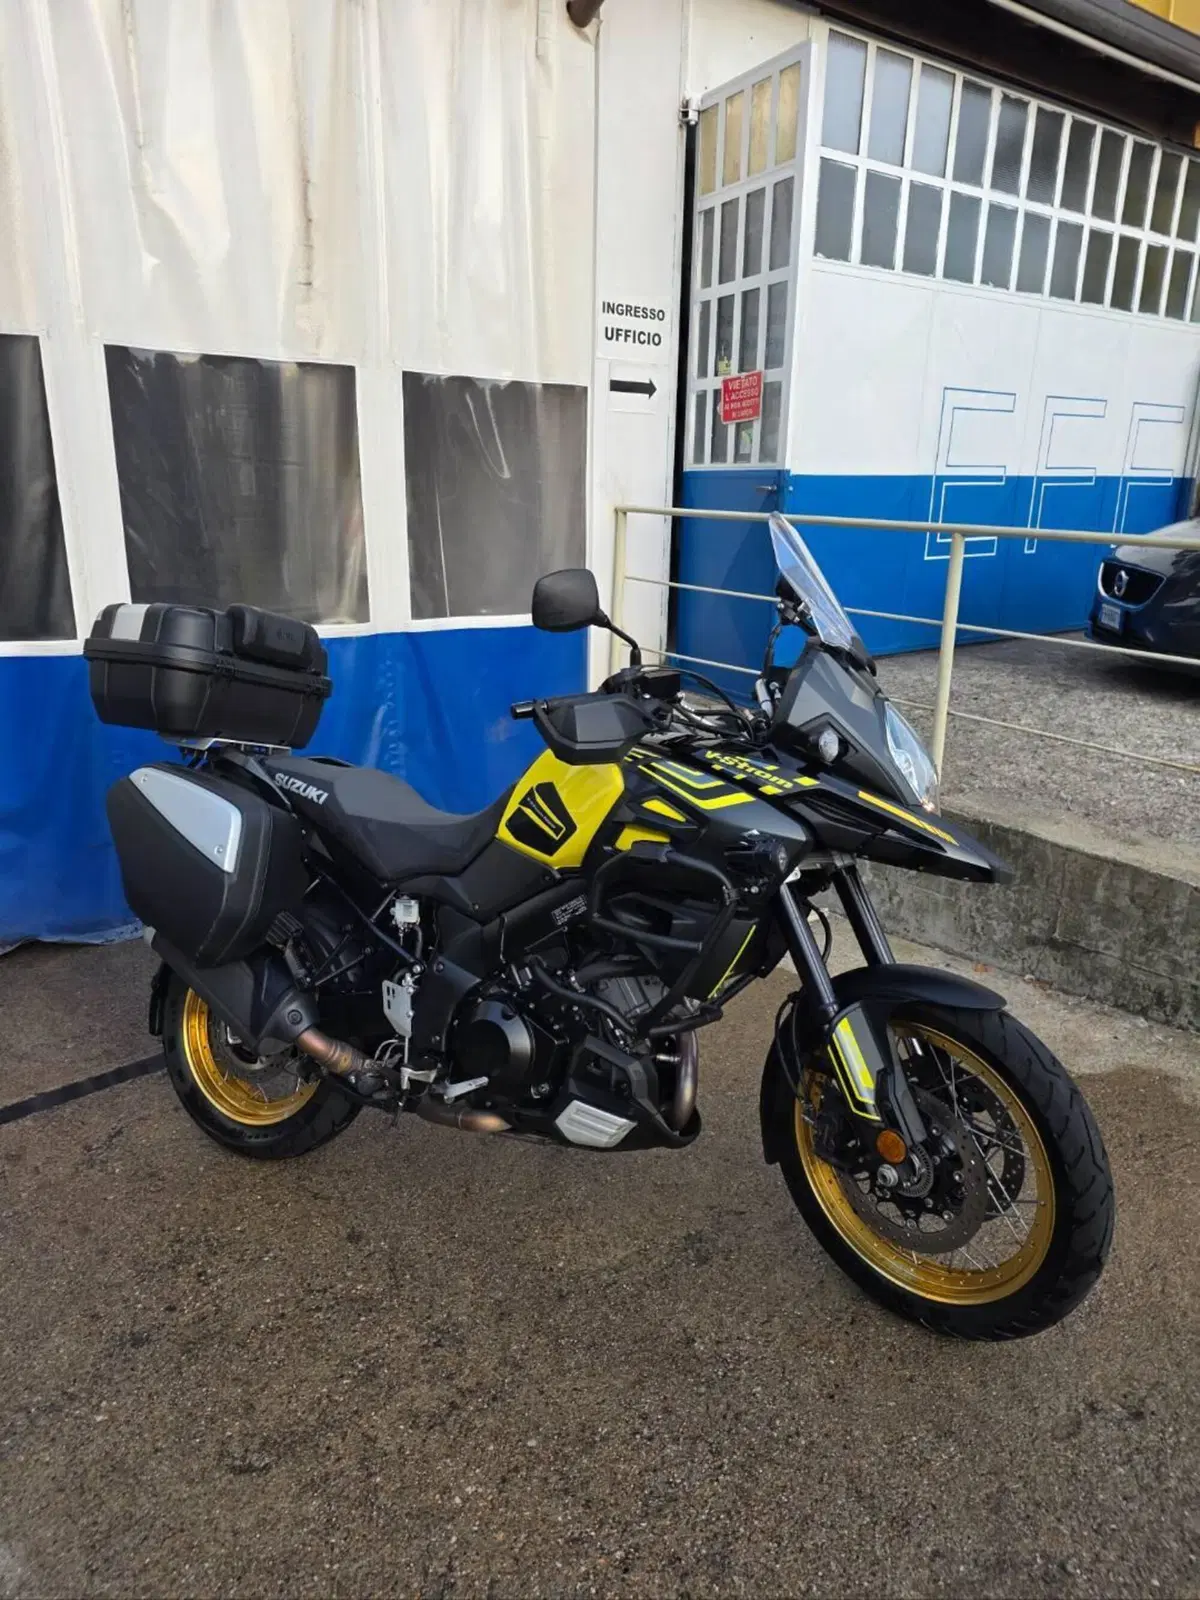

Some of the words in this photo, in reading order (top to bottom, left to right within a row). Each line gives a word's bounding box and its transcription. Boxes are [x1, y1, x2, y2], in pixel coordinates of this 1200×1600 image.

[602, 301, 665, 321] INGRESSO
[604, 326, 662, 347] UFFICIO
[728, 376, 758, 390] VIETATO
[275, 773, 329, 805] SUZUKI
